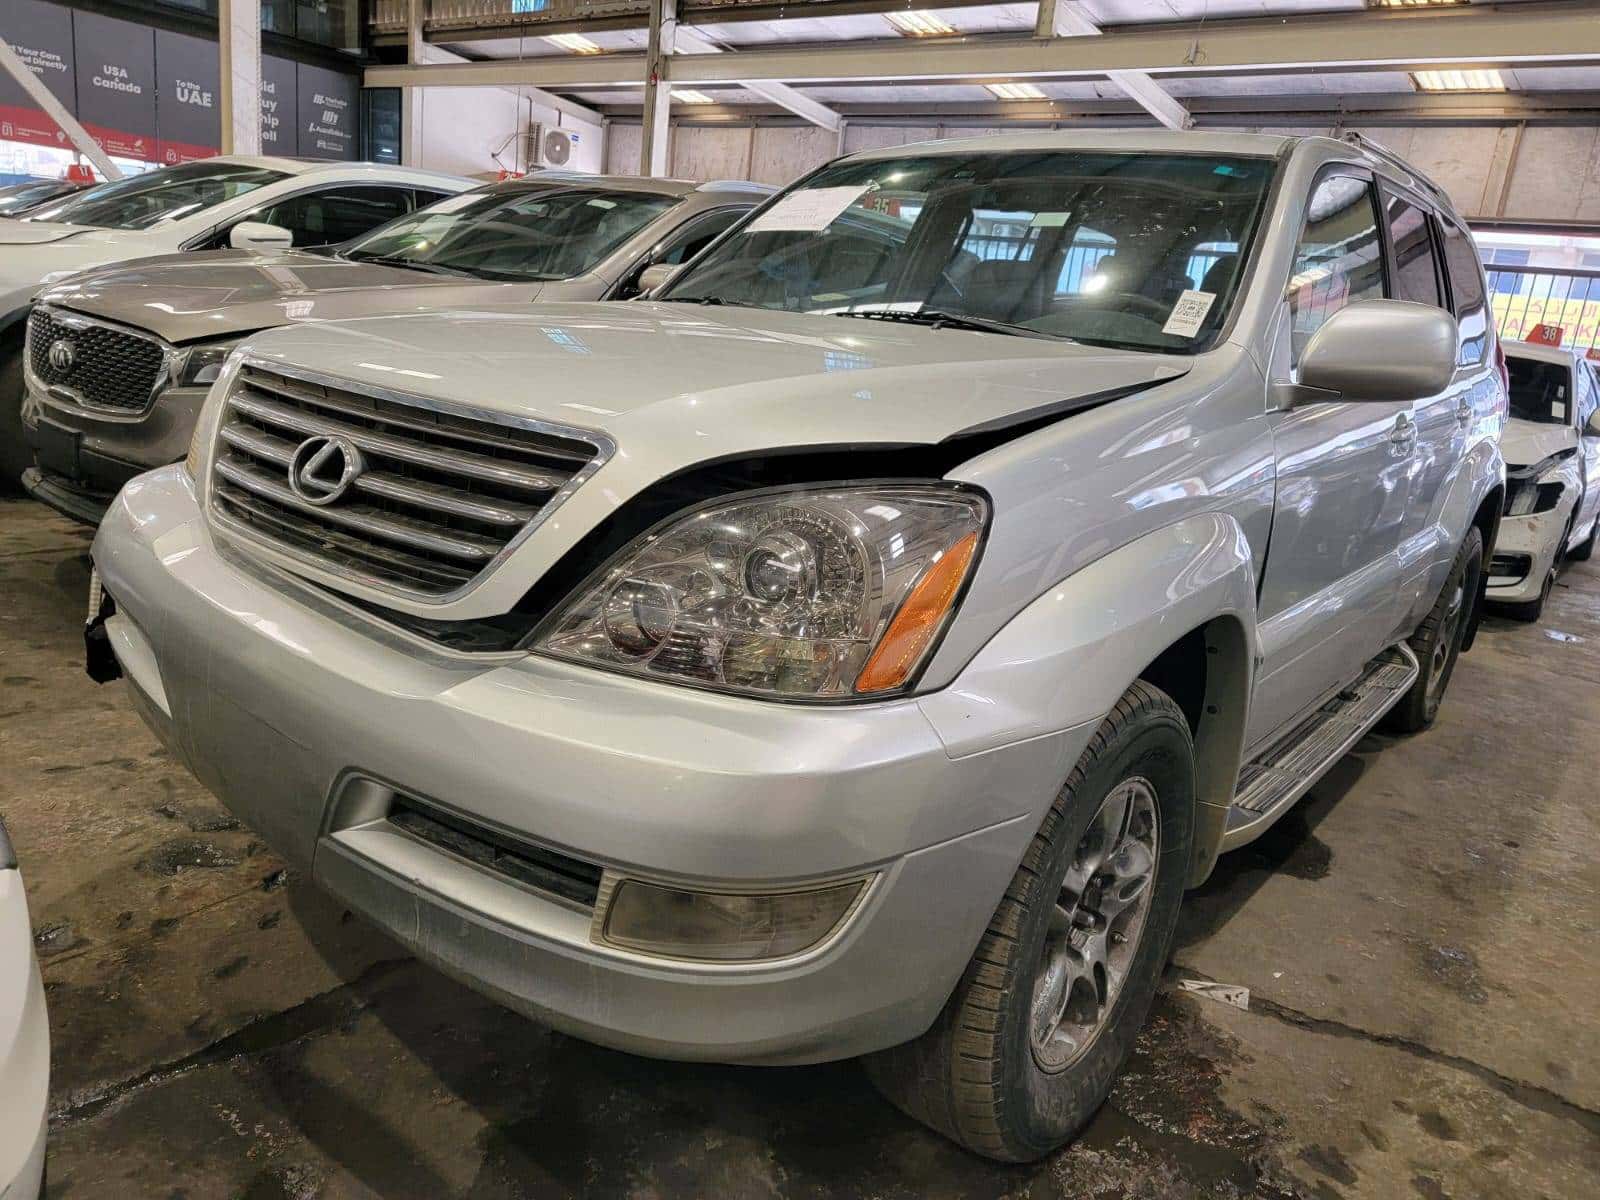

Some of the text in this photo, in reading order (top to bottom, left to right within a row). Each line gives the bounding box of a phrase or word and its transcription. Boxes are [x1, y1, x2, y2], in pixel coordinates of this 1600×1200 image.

[103, 64, 128, 78] USA
[92, 76, 141, 94] Canada
[176, 79, 201, 91] To the
[176, 87, 212, 107] UAE
[261, 99, 277, 112] uy
[1543, 326, 1557, 342] 38
